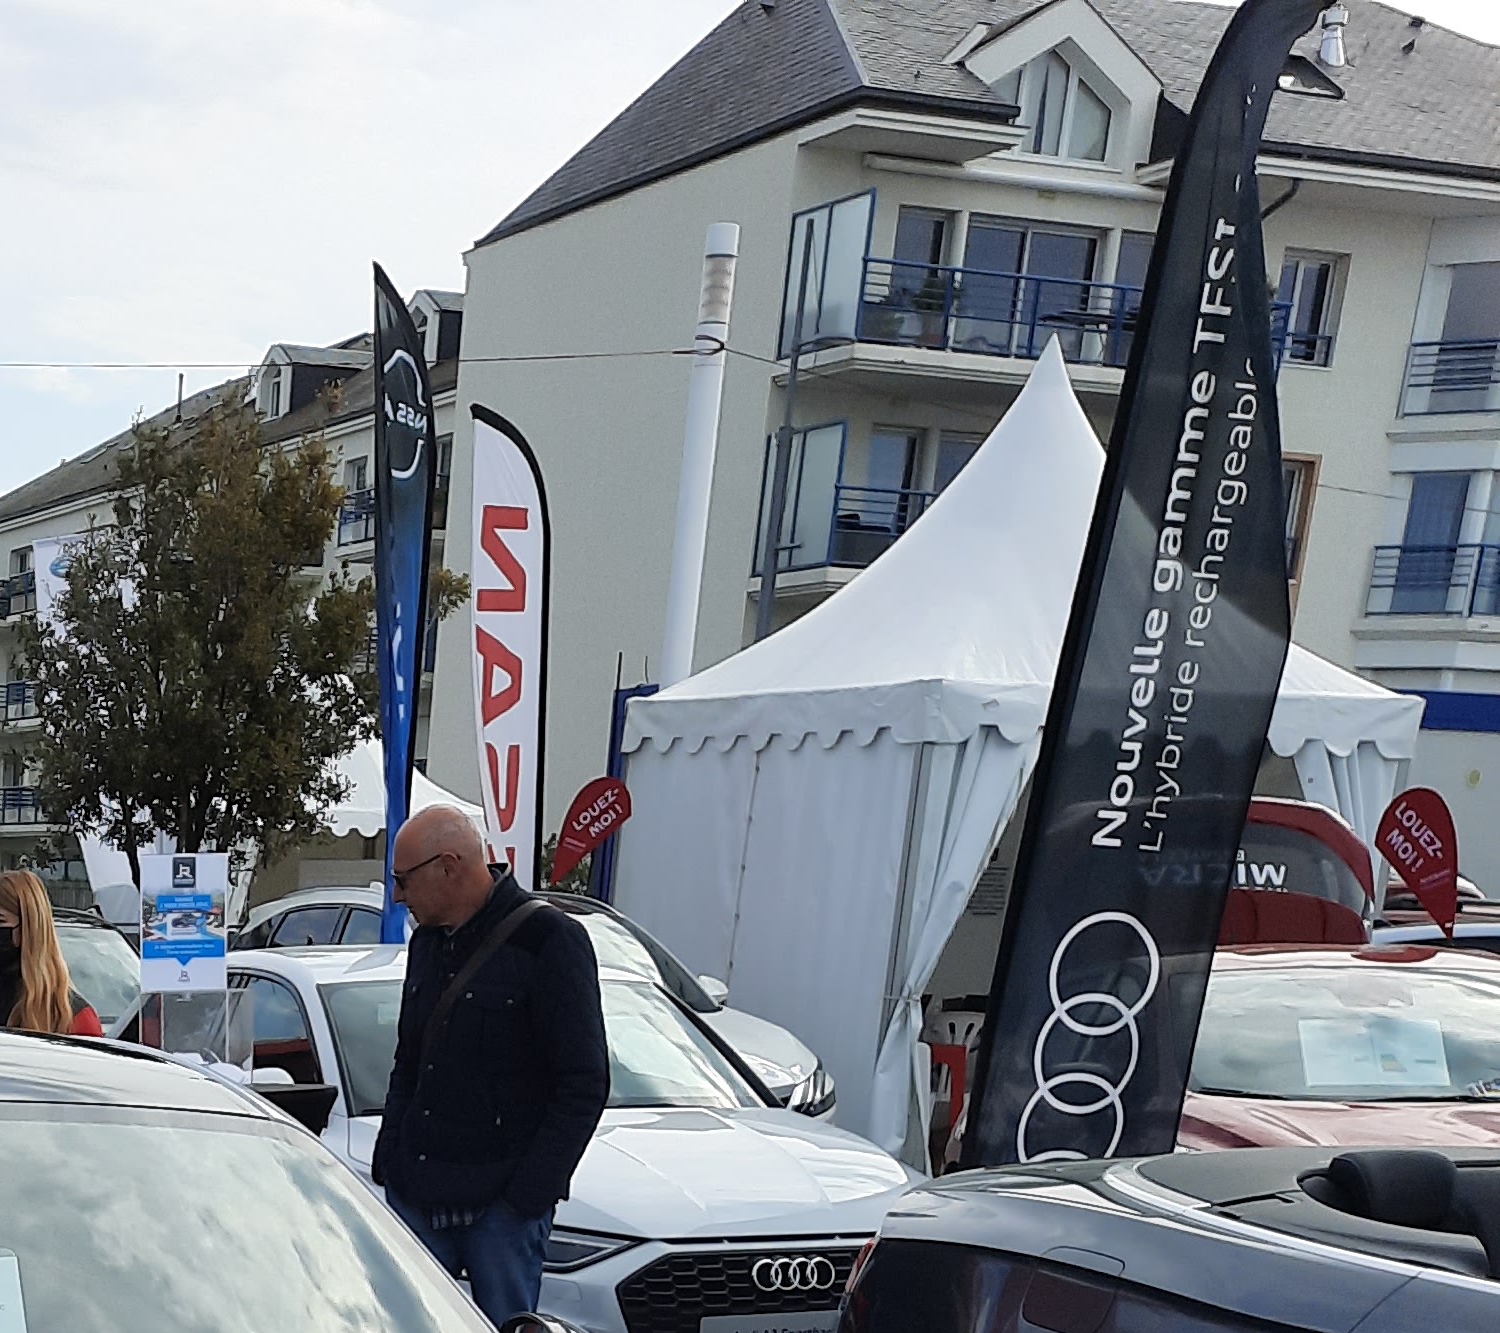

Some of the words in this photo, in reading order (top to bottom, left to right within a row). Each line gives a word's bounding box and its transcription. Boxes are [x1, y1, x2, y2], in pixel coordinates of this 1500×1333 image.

[1091, 606, 1169, 848] Nouvelle
[1152, 369, 1217, 593] gamme
[571, 787, 620, 832] LOUEZ-
[1138, 660, 1200, 852] L'hybride
[1394, 801, 1444, 860] LOUEZ-
